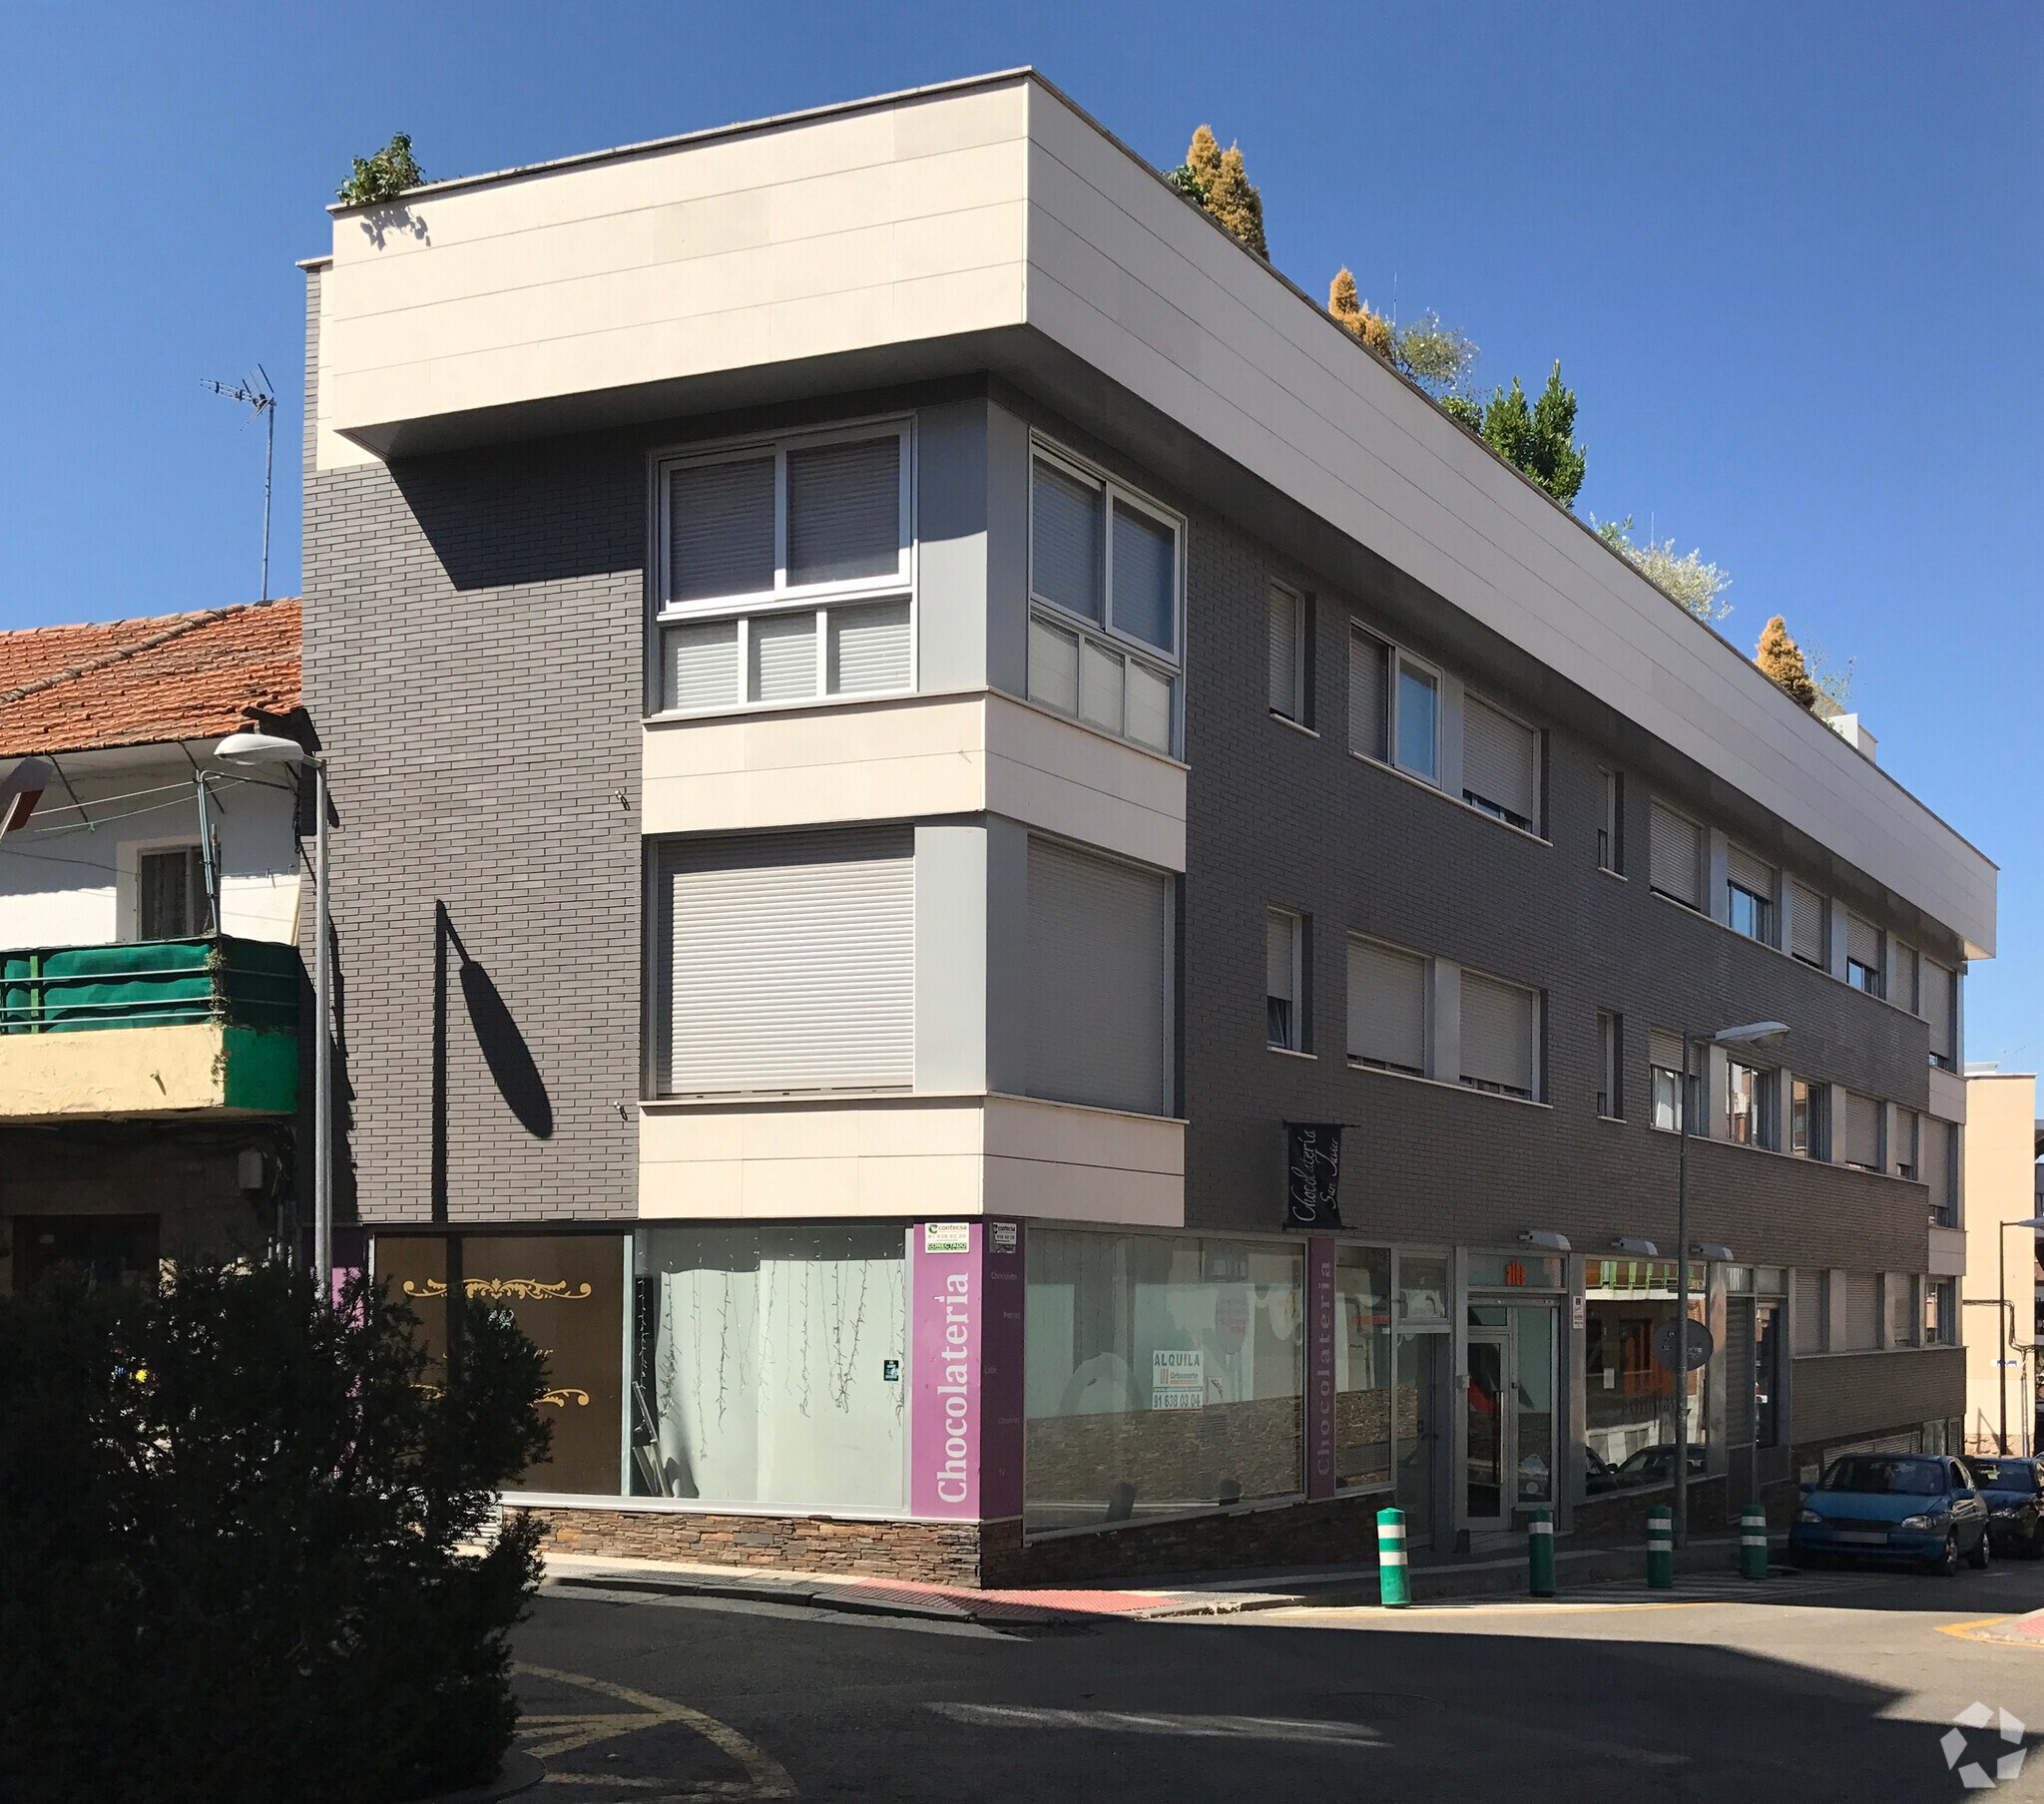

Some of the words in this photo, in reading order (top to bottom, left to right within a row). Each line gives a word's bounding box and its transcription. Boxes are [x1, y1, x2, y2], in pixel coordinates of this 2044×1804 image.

[1314, 1136, 1338, 1177] Javier
[1290, 1128, 1316, 1221] Chocolatería
[1319, 1182, 1336, 1209] San
[1154, 1353, 1201, 1367] ALQUILA
[1153, 1394, 1162, 1408] 91
[1164, 1394, 1179, 1408] 638
[1180, 1393, 1189, 1407] 03
[1190, 1393, 1201, 1407] 04
